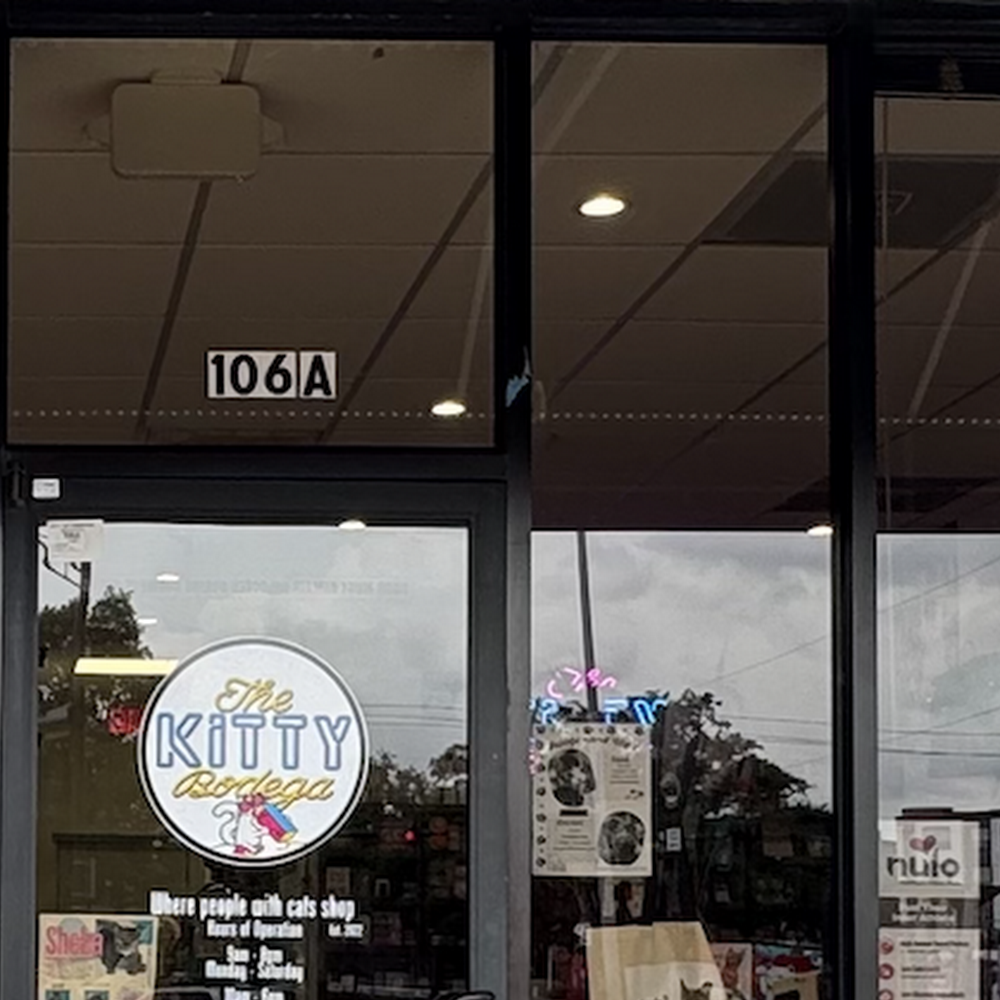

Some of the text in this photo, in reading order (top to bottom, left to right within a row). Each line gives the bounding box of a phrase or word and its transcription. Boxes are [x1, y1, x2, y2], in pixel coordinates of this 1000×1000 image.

[210, 353, 333, 396] 106A
[215, 677, 294, 714] The
[173, 769, 335, 811] Bodega
[150, 890, 356, 922] Where people with cats shop
[206, 919, 304, 940] Hours of Operation
[205, 959, 248, 982] Monday
[256, 960, 304, 984] Saturday
